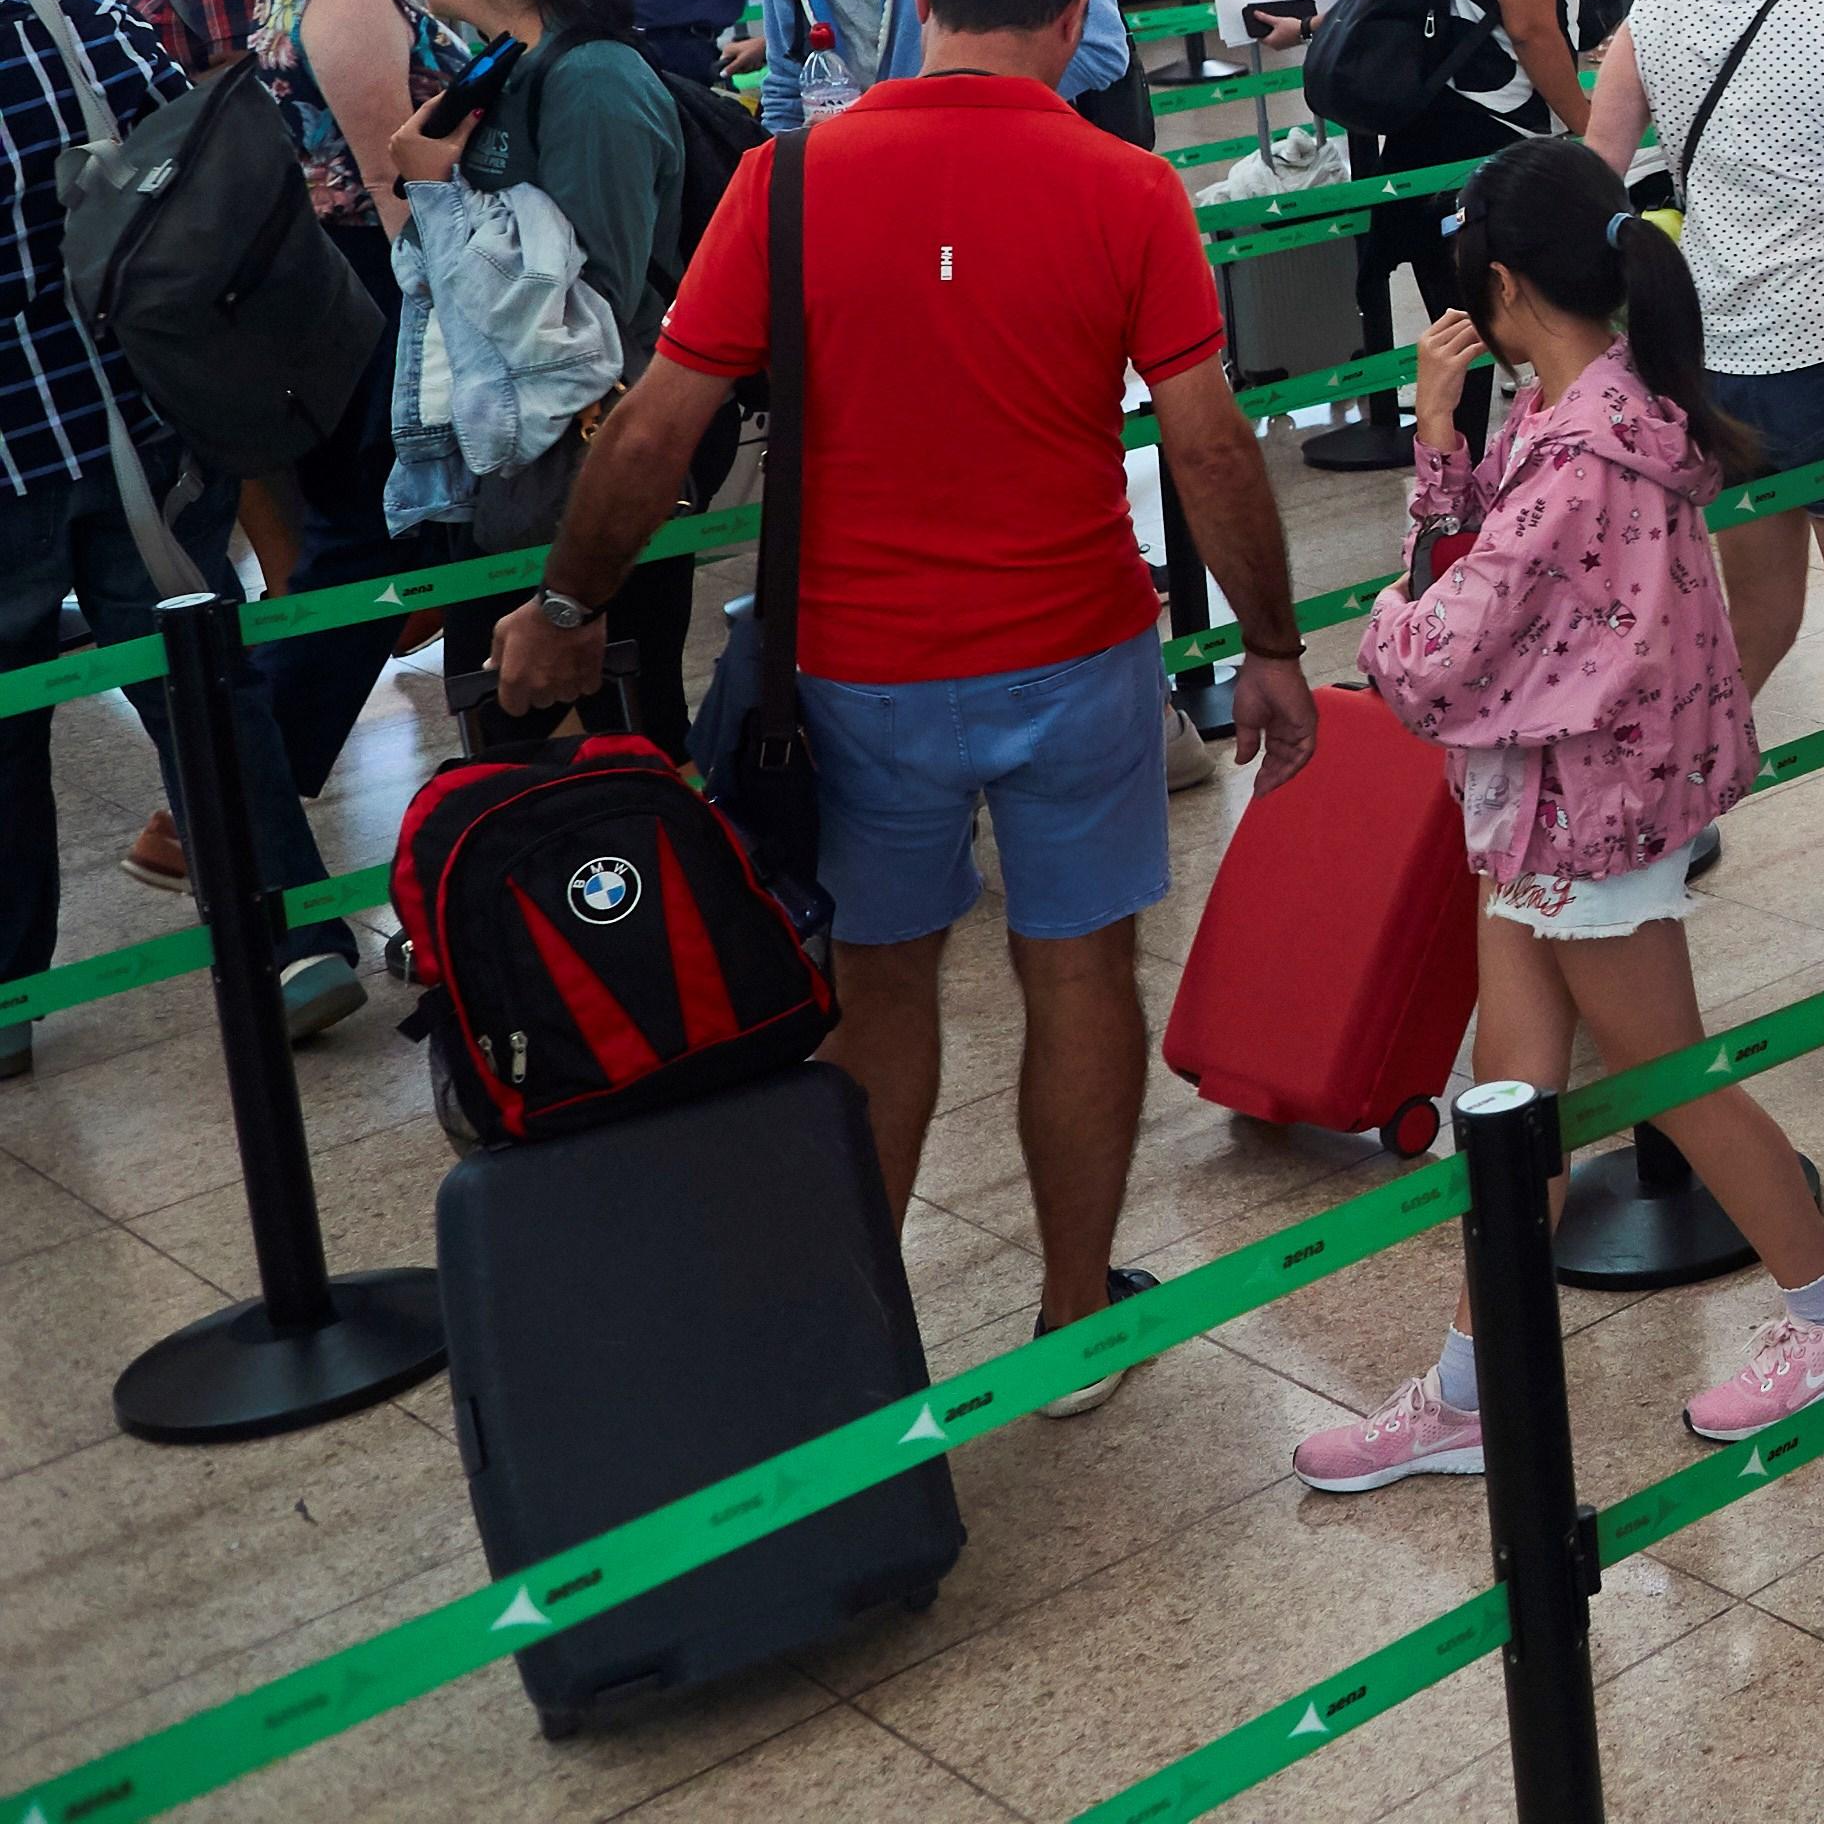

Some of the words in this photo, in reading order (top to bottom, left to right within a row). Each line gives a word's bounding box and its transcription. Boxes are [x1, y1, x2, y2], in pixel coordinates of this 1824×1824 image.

[1754, 490, 1777, 505] aena
[1514, 508, 1531, 538] OVER
[1531, 497, 1549, 529] HERE
[402, 582, 434, 599] aena
[1203, 638, 1227, 654] aena
[1774, 753, 1798, 771] aena
[573, 862, 629, 889] BMW
[1735, 1038, 1769, 1063] aena
[1282, 1238, 1326, 1270] aena
[943, 1390, 995, 1425] aena
[1766, 1434, 1800, 1464] aena
[545, 1567, 604, 1606] aena
[1325, 1683, 1368, 1717] aena
